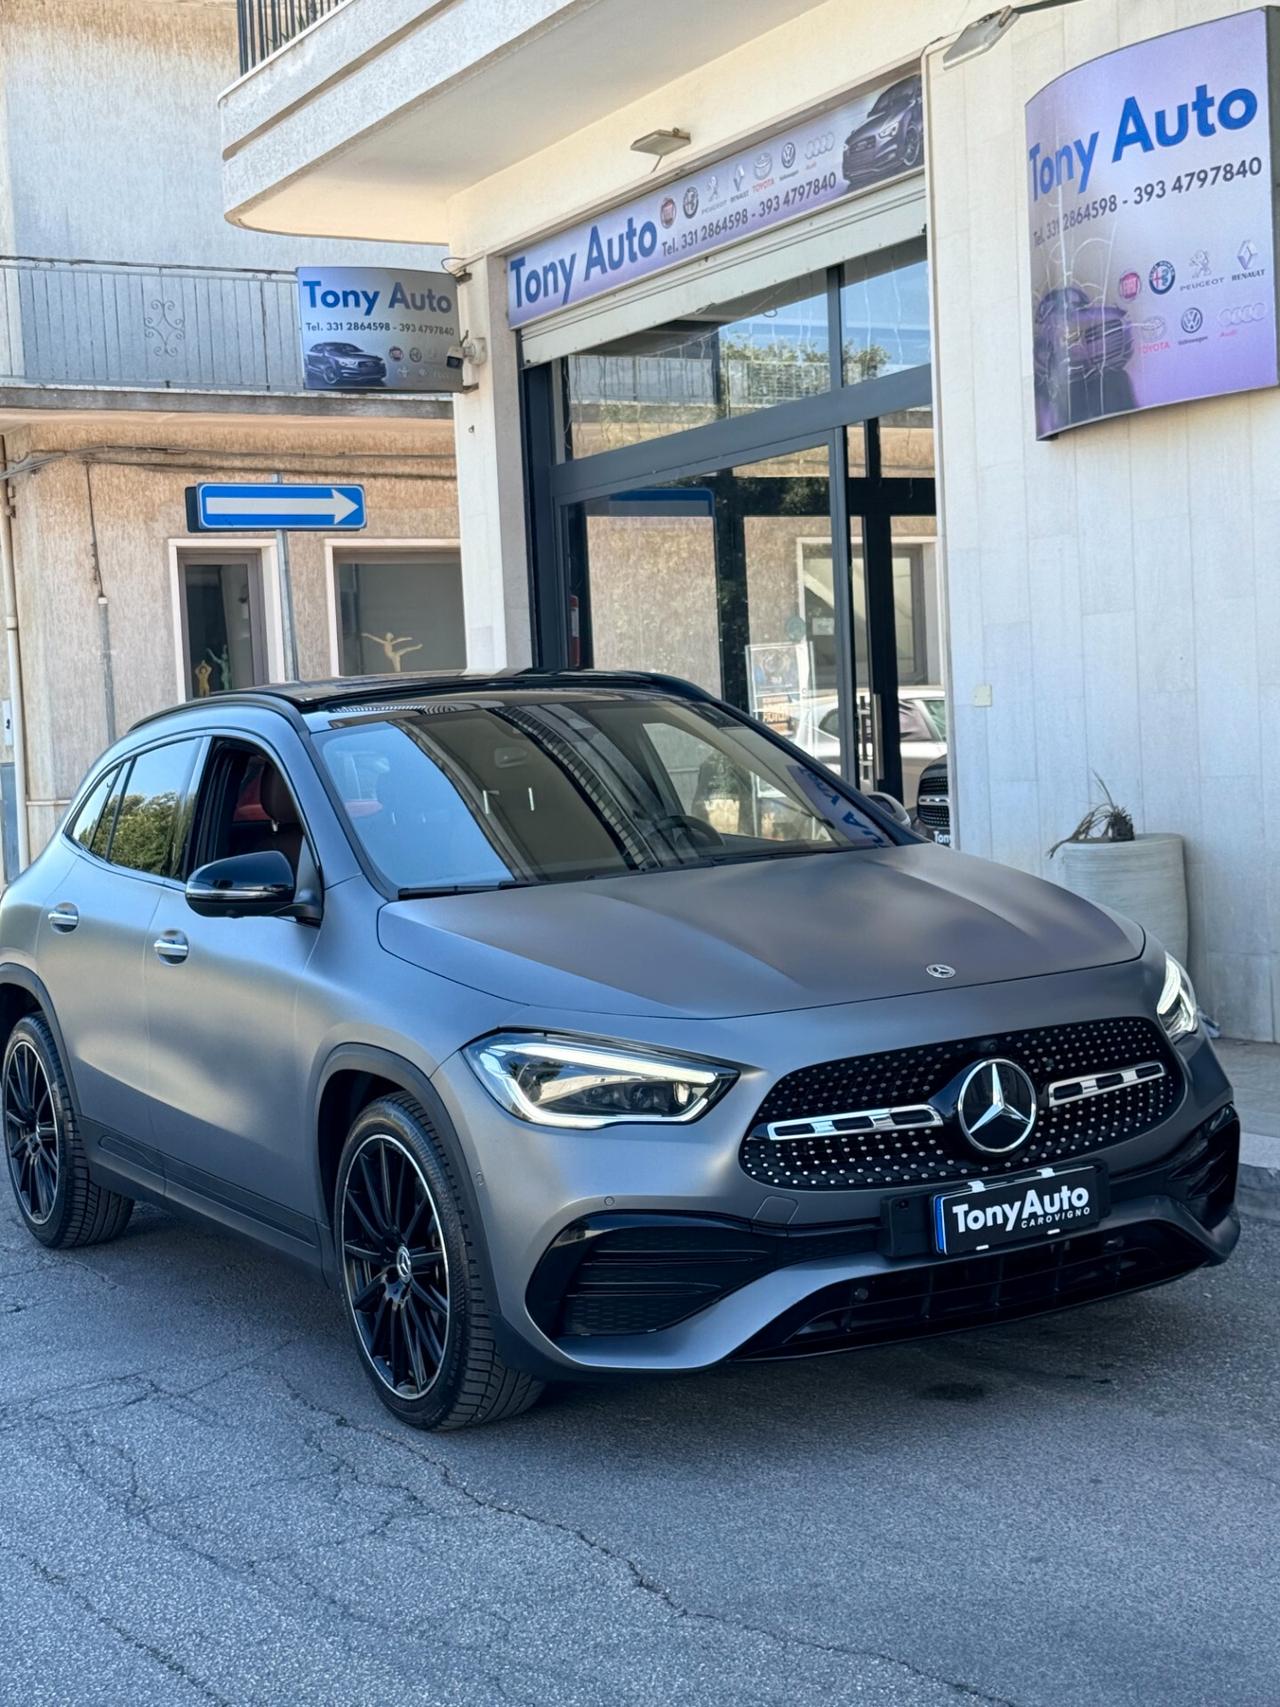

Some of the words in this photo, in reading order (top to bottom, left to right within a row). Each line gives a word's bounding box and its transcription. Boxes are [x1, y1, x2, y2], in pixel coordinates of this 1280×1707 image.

[1029, 131, 1099, 202] Tony
[1112, 84, 1258, 163] Auto
[662, 238, 679, 256] Tel.
[681, 231, 698, 249] 331
[701, 208, 748, 242] 2864598
[759, 195, 780, 218] 393
[783, 171, 836, 207] 4797840
[1047, 217, 1060, 239] 331
[1062, 195, 1117, 231] 2864598
[1133, 181, 1167, 205] 393
[1172, 157, 1262, 194] 4797840
[510, 253, 576, 308] Tony
[584, 217, 657, 281] Auto
[1180, 276, 1225, 291] PEUGEOT
[1231, 269, 1265, 281] RENAULT
[303, 280, 380, 316] Tony
[388, 281, 453, 313] Auto
[306, 322, 323, 331] Tel.
[326, 322, 343, 331] 331
[346, 322, 391, 331] 2864598
[399, 324, 417, 333] 393
[418, 325, 455, 336] 4797840
[1021, 1207, 1090, 1228] CAROVIGNO
